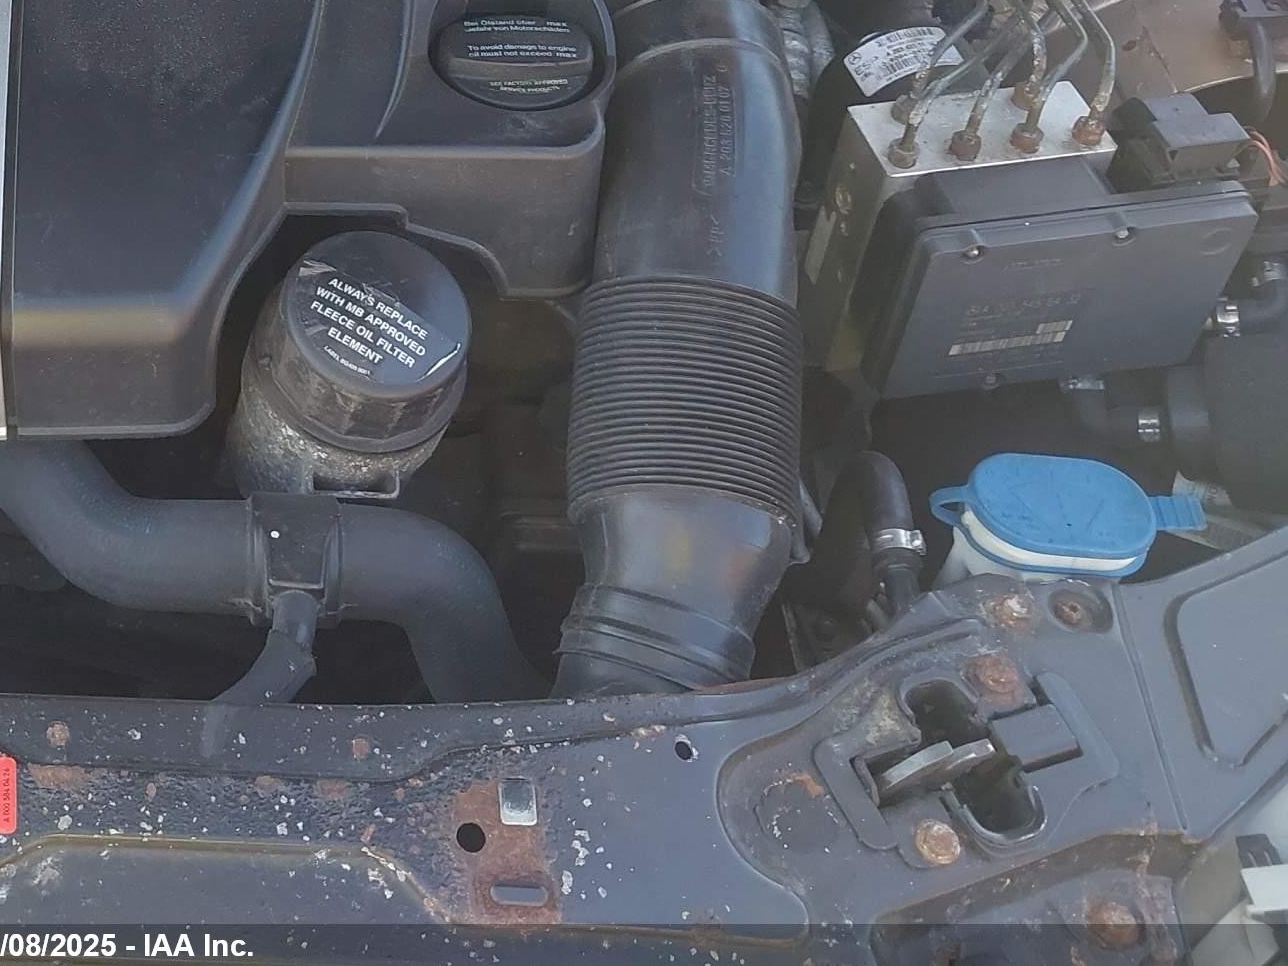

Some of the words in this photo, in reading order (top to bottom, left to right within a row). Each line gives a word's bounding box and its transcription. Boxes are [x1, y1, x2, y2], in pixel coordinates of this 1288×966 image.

[310, 302, 356, 330] FLEECE
[355, 325, 374, 343] OIL
[376, 337, 416, 368] FILTER
[316, 287, 345, 307] WITH
[346, 301, 364, 317] MB
[364, 314, 426, 356] APPROVED
[328, 278, 376, 306] ALWAYS
[376, 301, 428, 341] REPLACE
[327, 327, 383, 364] ELEMENT
